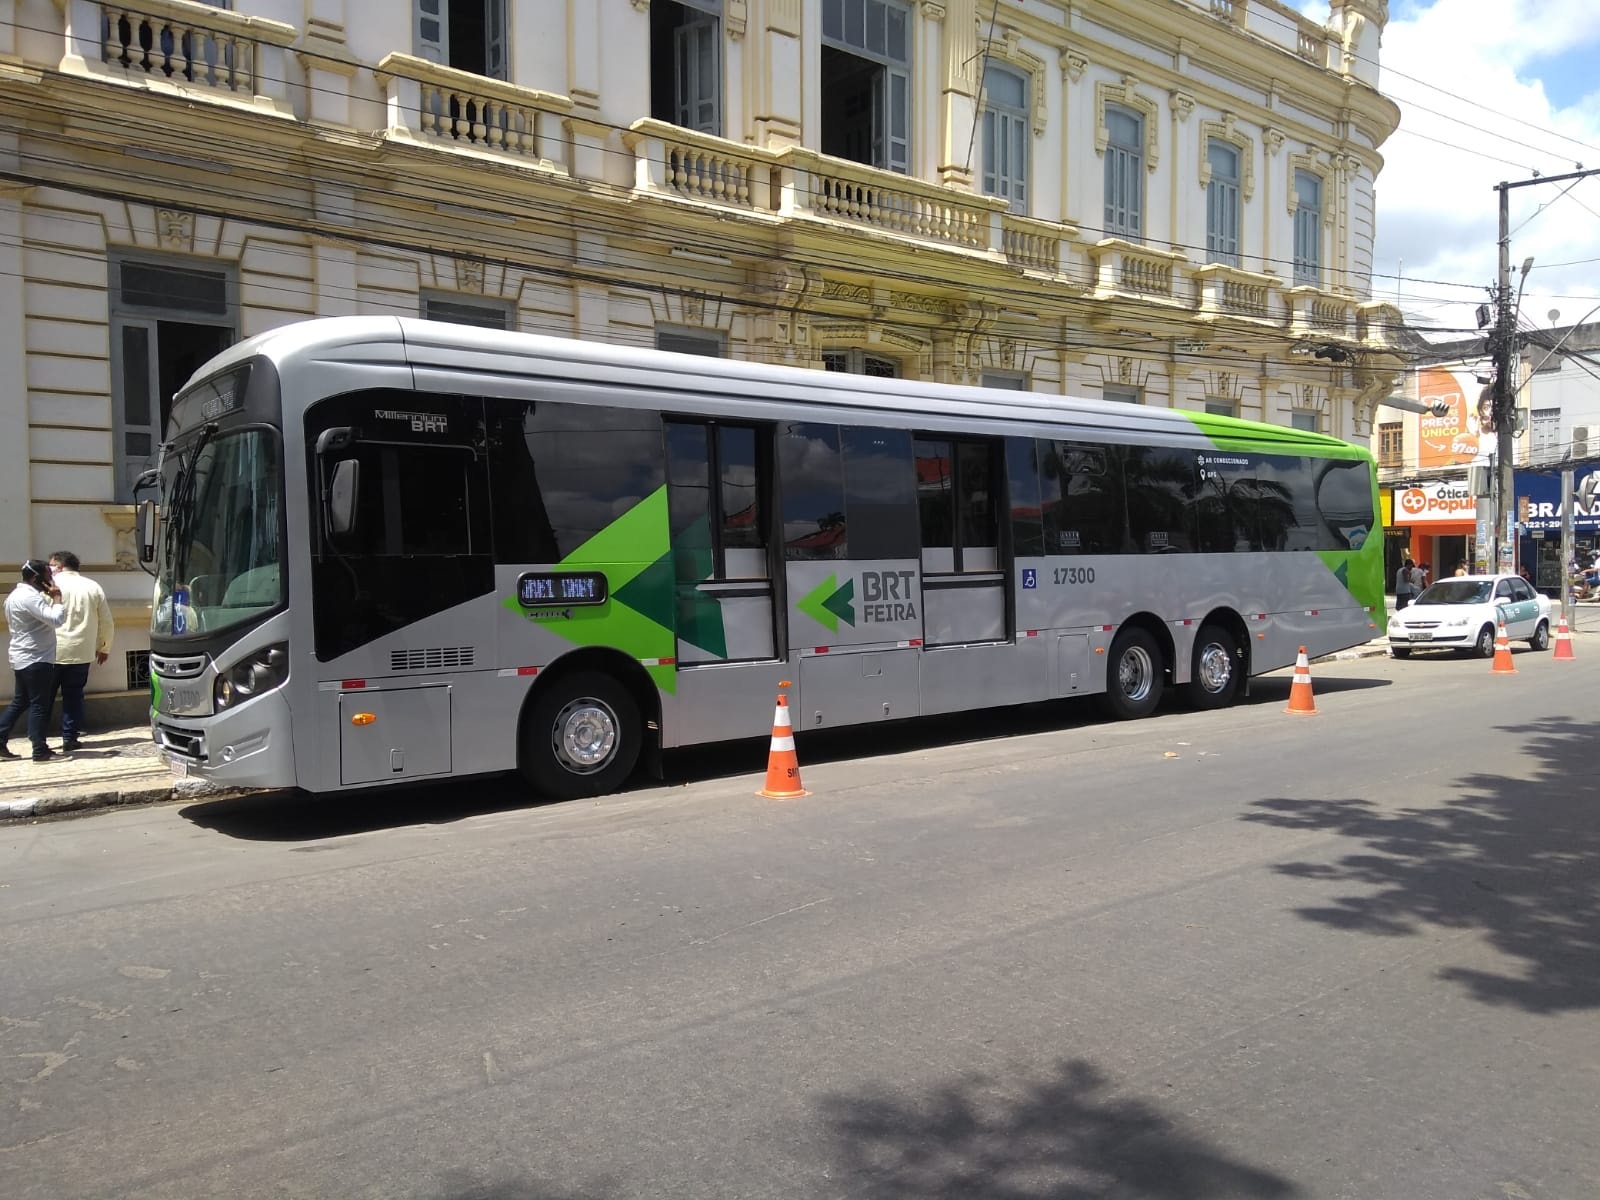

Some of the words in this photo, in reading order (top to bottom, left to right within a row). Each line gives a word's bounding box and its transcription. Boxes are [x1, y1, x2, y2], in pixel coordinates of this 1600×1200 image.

[411, 421, 447, 432] BRT
[1421, 416, 1459, 428] PREÇO
[1421, 426, 1459, 438] ÚNICO
[1053, 567, 1095, 585] 17300
[862, 571, 915, 601] BRT
[864, 602, 917, 623] FEIRA
